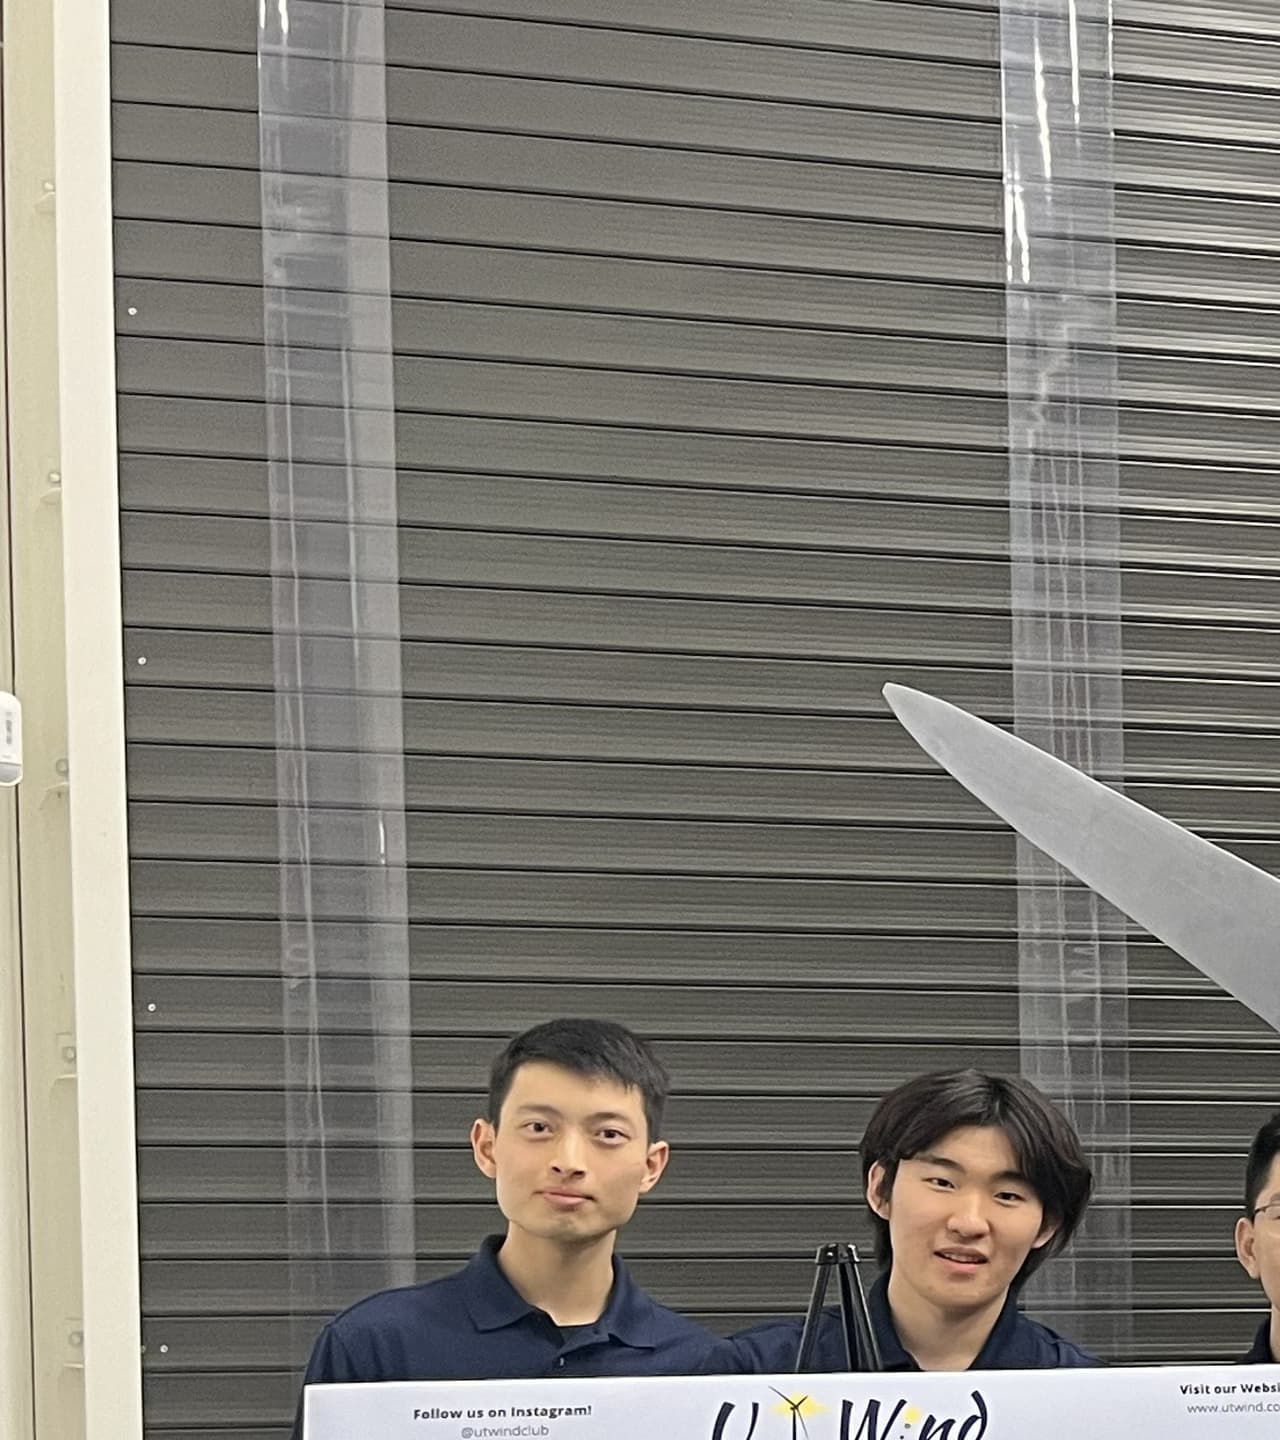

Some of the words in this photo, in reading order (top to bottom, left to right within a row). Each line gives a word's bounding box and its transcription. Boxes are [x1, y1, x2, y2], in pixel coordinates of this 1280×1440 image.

[1180, 1384, 1210, 1394] Visit
[1214, 1386, 1237, 1394] our
[414, 1408, 462, 1420] Follow
[467, 1410, 483, 1418] us
[511, 1405, 591, 1419] Instagram!
[461, 1425, 549, 1439] @utwindclub
